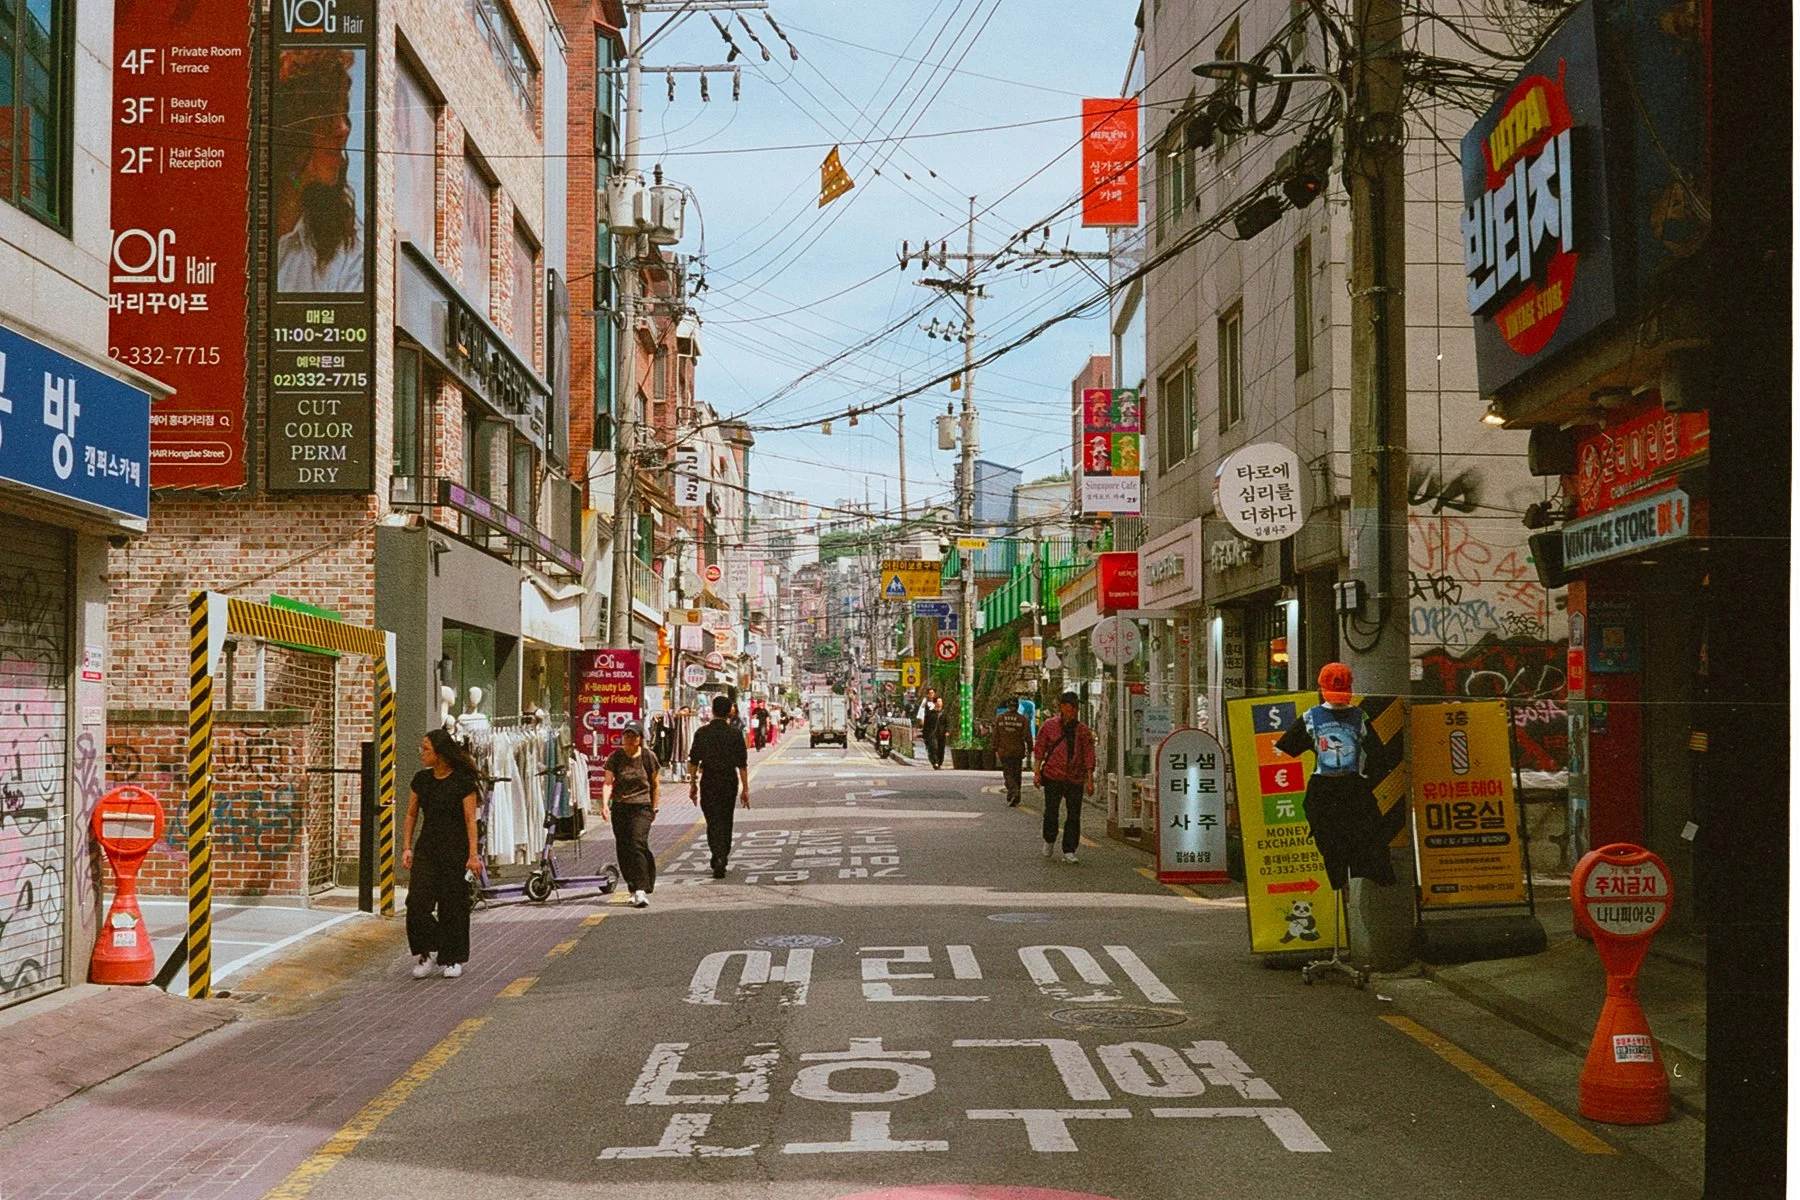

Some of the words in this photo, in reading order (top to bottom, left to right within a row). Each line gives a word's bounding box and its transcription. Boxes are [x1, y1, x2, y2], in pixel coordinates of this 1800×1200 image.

[284, 0, 336, 33] VOG
[343, 16, 364, 33] Hair
[120, 49, 155, 75] 4F
[171, 46, 208, 57] Private
[210, 46, 242, 57] Room
[170, 62, 209, 73] Terrace
[120, 97, 155, 124] 3F
[170, 98, 208, 110] Beauty
[170, 113, 194, 123] Hair
[197, 113, 225, 123] Salon
[1490, 87, 1546, 172] ULTRA
[119, 148, 154, 174] 2F
[169, 148, 194, 158] Hair
[196, 148, 225, 158] Salon
[168, 158, 222, 170] Reception
[1461, 128, 1572, 315] 빈티지
[108, 228, 176, 283] OG
[186, 256, 217, 284] Hair
[108, 292, 209, 314] 파리꾸아프
[306, 309, 335, 324] 매일
[273, 328, 367, 342] 11:00~21:00
[296, 355, 345, 368] 예약문의
[273, 373, 367, 387] 02)332-7715
[297, 400, 341, 416] CUT
[169, 414, 214, 426] 홍대거리점
[285, 422, 353, 438] COLOR
[150, 449, 168, 458] HAIR
[168, 448, 202, 460] Hongdae
[202, 449, 225, 458] Street
[291, 445, 347, 460] PERM
[84, 445, 140, 487] 캠퍼스카페
[1236, 462, 1290, 482] 타로에
[298, 467, 339, 483] DRY
[1085, 480, 1120, 491] Singapore
[1120, 480, 1138, 490] Cafe
[1239, 483, 1295, 503] 심리를
[1240, 504, 1298, 524] 더하다
[1565, 518, 1614, 561] VINTAGE
[1614, 506, 1658, 546] STORE
[612, 670, 634, 679] SEOUL
[585, 682, 616, 694] K-Beauty
[617, 682, 631, 692] Lab
[611, 694, 638, 705] Friendly
[1444, 710, 1469, 726] 3층
[1423, 779, 1503, 800] 유아트헤어
[1425, 800, 1505, 831] 미용실
[1266, 825, 1308, 838] MONEY
[1263, 851, 1319, 865] 홍대바오환전
[1594, 876, 1657, 896] 주차금지
[1596, 906, 1656, 924] 나나피어싱
[685, 944, 1184, 1006] 어린이
[596, 1035, 1333, 1161] 보호구역
